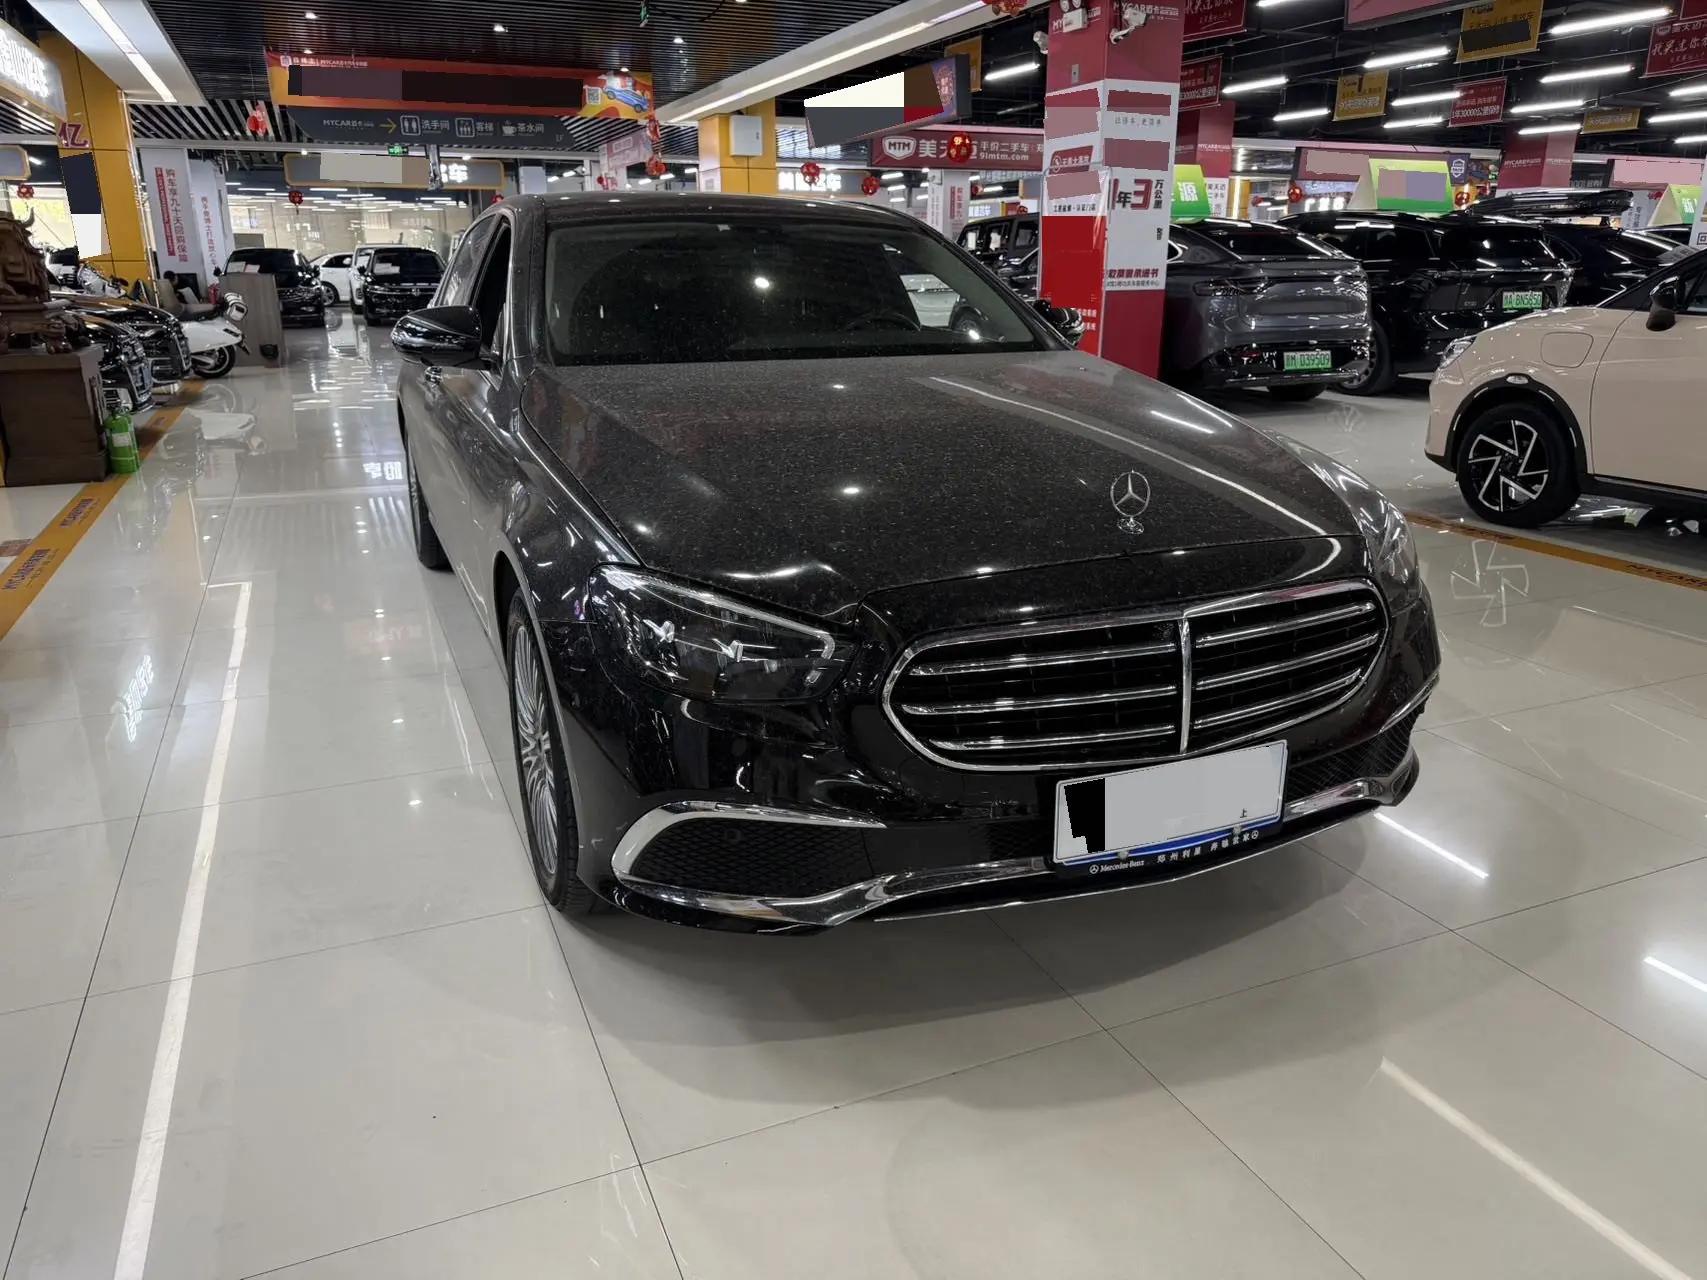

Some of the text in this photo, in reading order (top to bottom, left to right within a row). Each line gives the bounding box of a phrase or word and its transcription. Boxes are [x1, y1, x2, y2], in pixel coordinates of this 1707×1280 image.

[422, 119, 450, 131] 洗手间
[476, 120, 494, 132] 客梯
[517, 122, 545, 134] 茶水间
[57, 120, 91, 148] 亿
[888, 140, 911, 151] MTM
[980, 141, 1030, 153] 平价二手车
[1100, 859, 1145, 873] Mercedes-Benz
